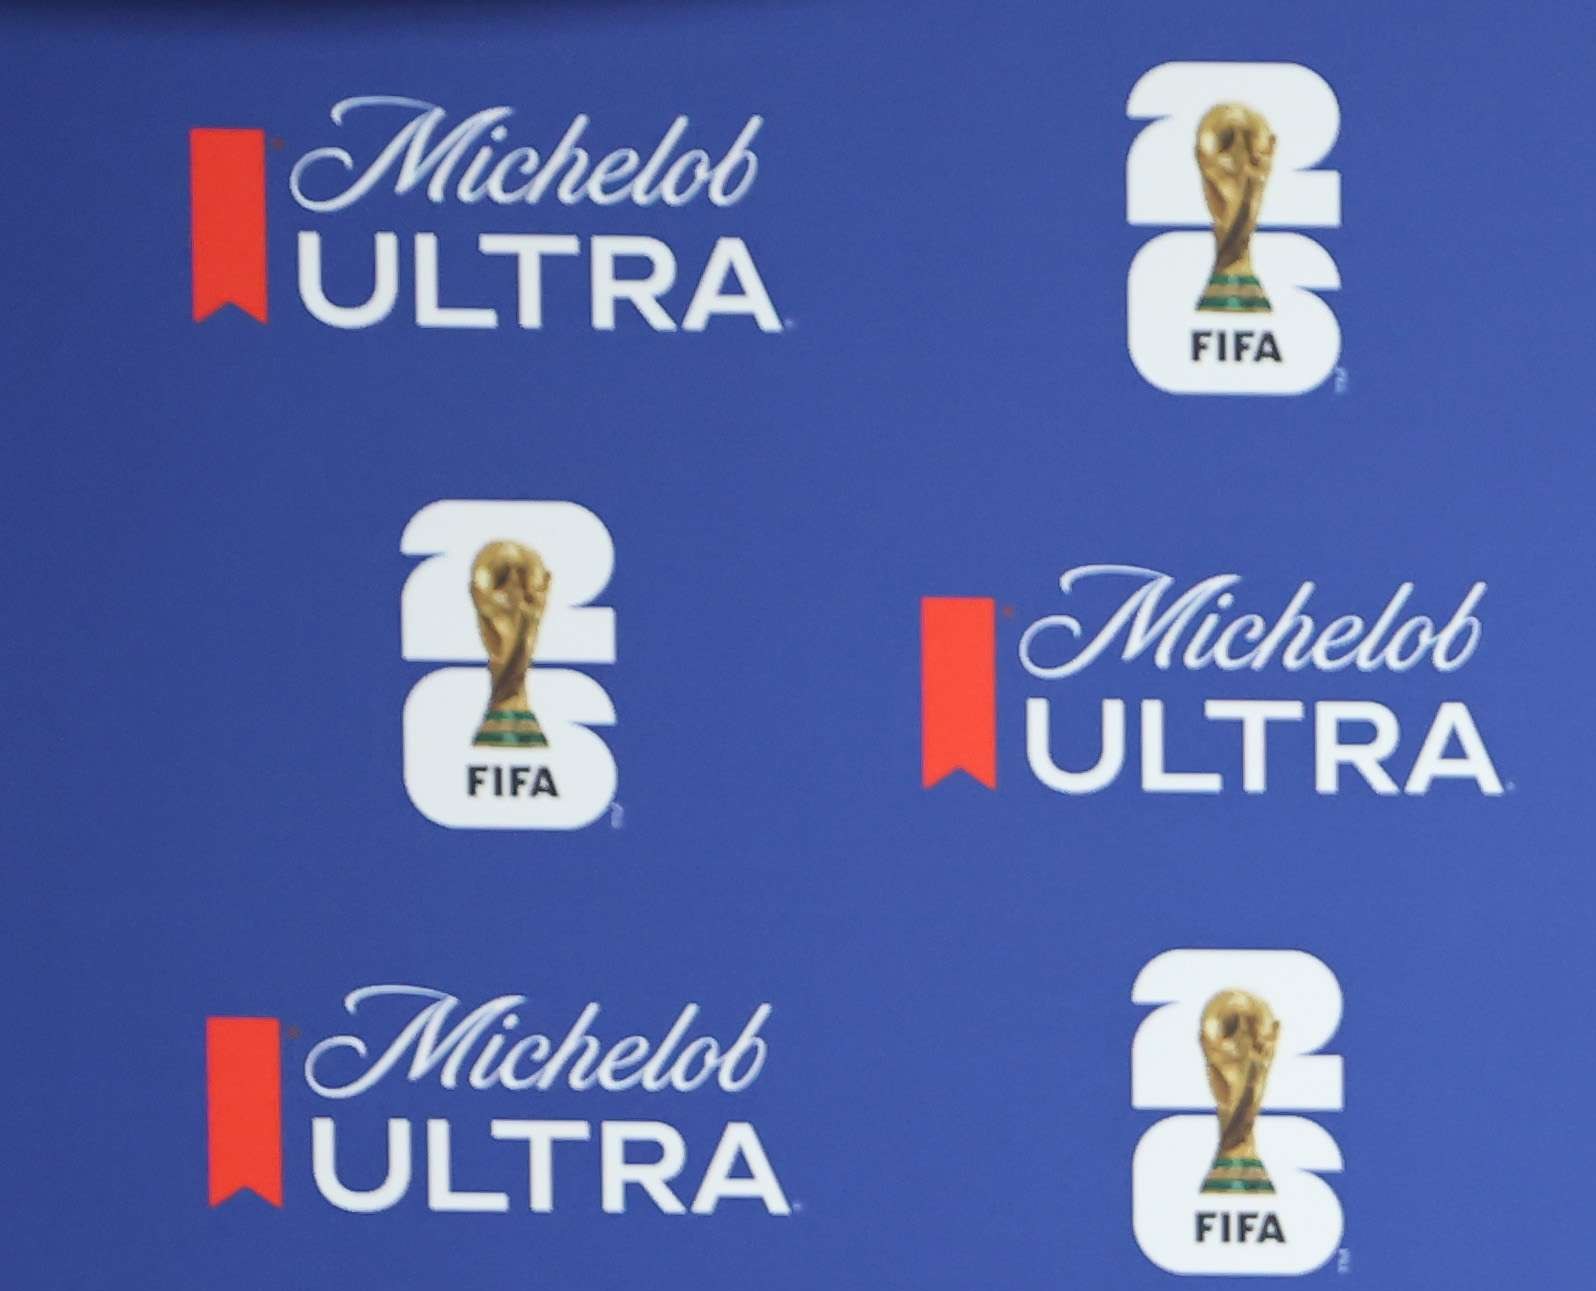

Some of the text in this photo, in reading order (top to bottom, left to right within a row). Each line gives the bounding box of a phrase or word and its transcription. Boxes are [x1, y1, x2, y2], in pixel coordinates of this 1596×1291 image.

[290, 97, 763, 212] Michelob
[298, 231, 783, 332] ULTRA
[1192, 332, 1281, 362] FIFA
[1019, 565, 1486, 678] Michelob
[469, 766, 558, 796] FIFA
[1026, 698, 1504, 795] ULTRA
[305, 985, 771, 1098] Michelob
[312, 1117, 790, 1215] ULTRA
[1197, 1213, 1285, 1242] FIFA
